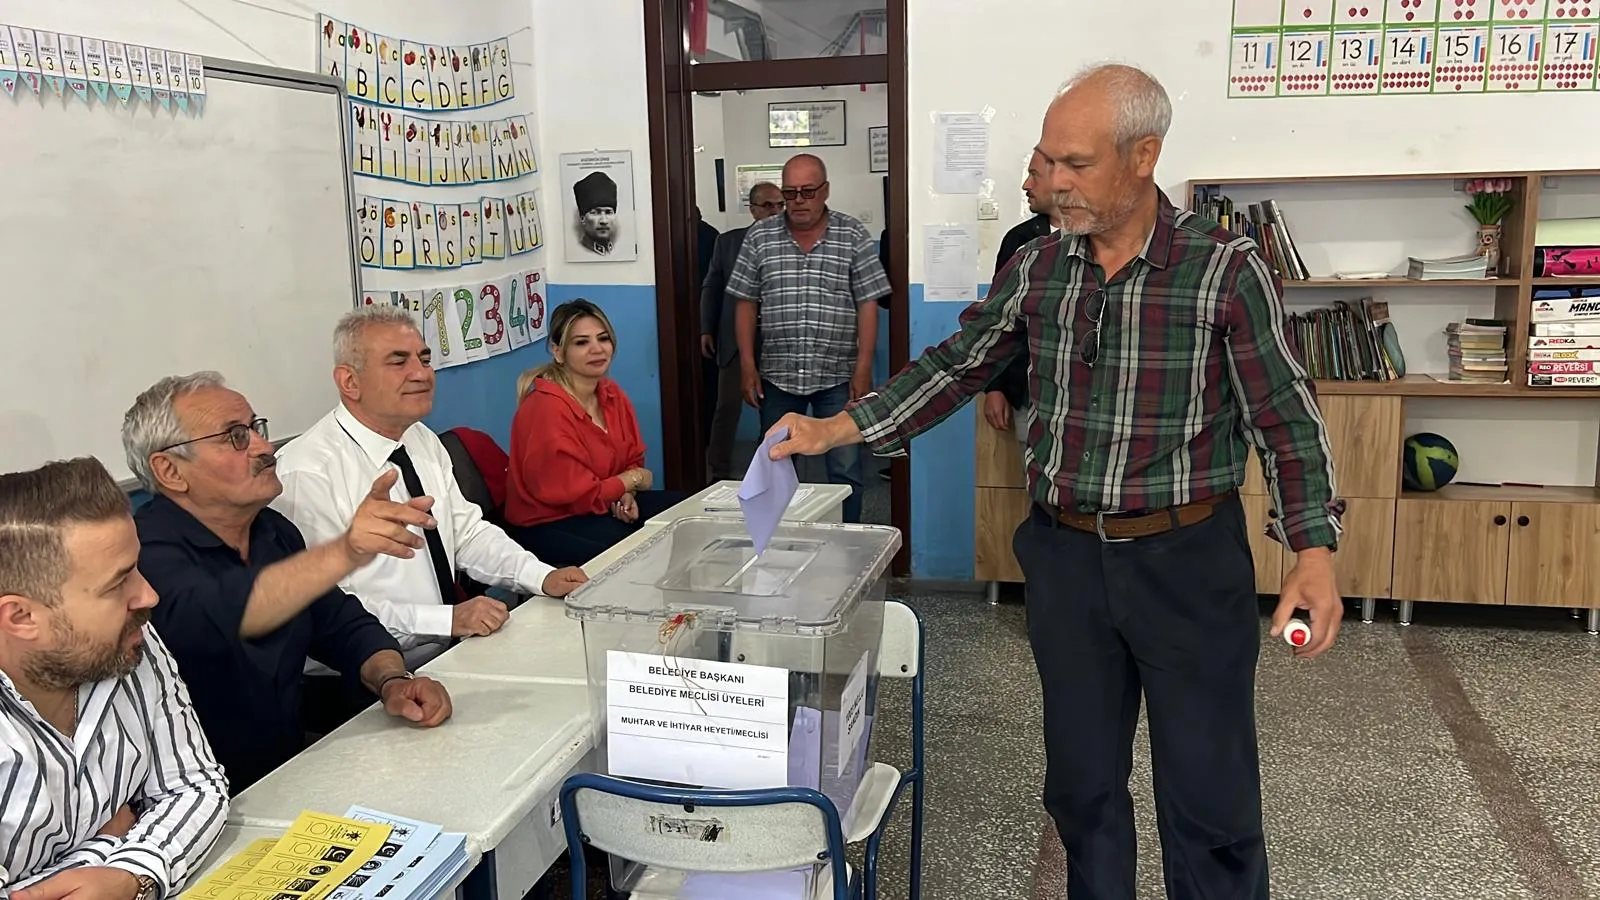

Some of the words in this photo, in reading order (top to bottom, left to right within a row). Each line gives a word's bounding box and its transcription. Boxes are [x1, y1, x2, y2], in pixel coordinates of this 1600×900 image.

[338, 34, 345, 46] a
[365, 32, 372, 54] b
[392, 50, 398, 61] c
[440, 47, 447, 67] d
[462, 56, 468, 66] e
[500, 49, 507, 67] g
[1244, 42, 1258, 62] 11
[1290, 41, 1312, 61] 12
[1341, 39, 1362, 59] 13
[1392, 37, 1415, 58] 14
[1445, 36, 1470, 56] 15
[1500, 34, 1522, 55] 16
[1555, 32, 1578, 53] 17
[24, 53, 33, 67] 2
[46, 57, 54, 71] 3
[69, 60, 77, 73] 4
[92, 63, 100, 77] 5
[115, 66, 122, 79] 6
[135, 68, 142, 82] 7
[155, 71, 162, 85] 8
[175, 74, 181, 87] 9
[191, 77, 201, 90] 10
[357, 68, 368, 97] B
[384, 76, 396, 104] C
[411, 79, 425, 108] Ç
[438, 82, 450, 108] D
[460, 82, 469, 107] E
[481, 79, 489, 103] F
[498, 74, 509, 98] G
[369, 107, 376, 130] h
[503, 128, 511, 140] m
[519, 125, 526, 137] n
[360, 143, 374, 173] H
[439, 158, 448, 182] J
[462, 157, 471, 182] K
[479, 156, 487, 180] L
[498, 153, 514, 178] M
[518, 148, 532, 172] N
[370, 205, 377, 220] ö
[401, 214, 408, 232] p
[425, 214, 431, 224] r
[451, 215, 456, 226] s
[496, 203, 500, 219] t
[361, 227, 375, 263] Ö
[393, 239, 403, 265] P
[423, 239, 432, 265] R
[446, 241, 454, 265] S
[469, 235, 476, 262] Ş
[489, 232, 498, 255] T
[528, 218, 538, 246] Ü
[424, 292, 450, 356] 1
[454, 288, 483, 350] 2
[480, 284, 504, 345] 3
[509, 279, 526, 336] 4
[525, 272, 544, 329] 5
[648, 666, 697, 679] BELEDİYE
[700, 671, 744, 684] BAŞKANI
[629, 685, 677, 698] BELEDİYE
[680, 689, 720, 702] MECLİSİ
[722, 693, 765, 707] ÜYELERİ
[621, 716, 655, 727] MUHTAR
[657, 720, 668, 728] VE
[669, 721, 702, 732] İHTİYAR
[704, 726, 769, 740] HEYETİ/MECLİSİ
